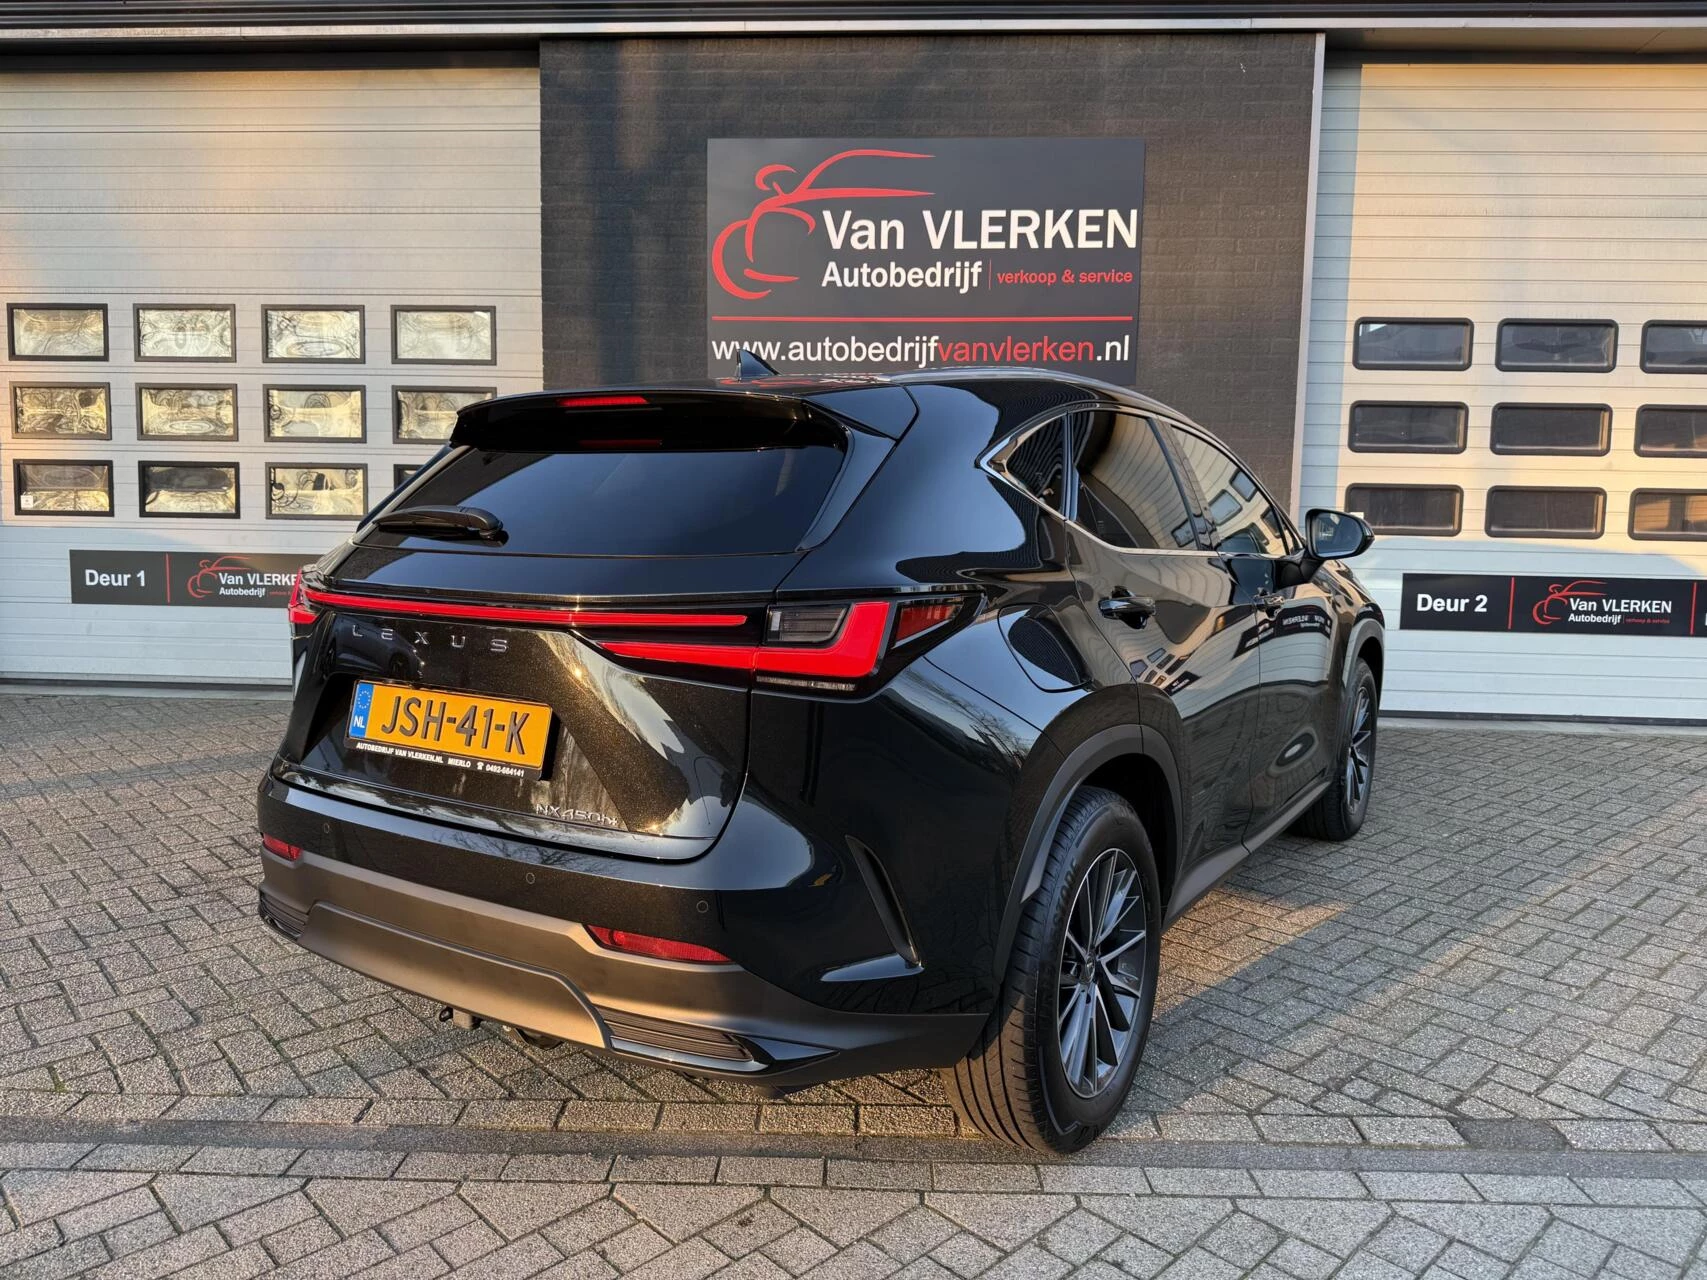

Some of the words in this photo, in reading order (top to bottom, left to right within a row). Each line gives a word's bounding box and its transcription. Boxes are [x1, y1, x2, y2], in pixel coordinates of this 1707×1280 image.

[822, 210, 905, 250] Van
[922, 209, 1138, 249] VLERKEN
[821, 261, 983, 294] Autobedrijf
[997, 269, 1057, 285] verkoop
[1061, 269, 1076, 284] &
[1079, 269, 1133, 284] service
[84, 569, 131, 586] Deur
[136, 570, 145, 587] 1
[219, 573, 243, 585] Van
[247, 573, 298, 586] VLERKE
[219, 587, 266, 598] Autobedrijf
[1416, 593, 1470, 612] Deur
[1474, 594, 1488, 613] 2
[1570, 598, 1597, 611] Van
[1602, 599, 1672, 613] VLERKEN
[1568, 613, 1622, 625] Autobedrijf
[352, 625, 508, 653] LEXUS
[353, 715, 366, 730] NL
[381, 696, 530, 755] JSH-41-K
[356, 742, 394, 755] AUTOBEDRIJF
[395, 748, 408, 758] VAN
[447, 757, 472, 769] MIERLO
